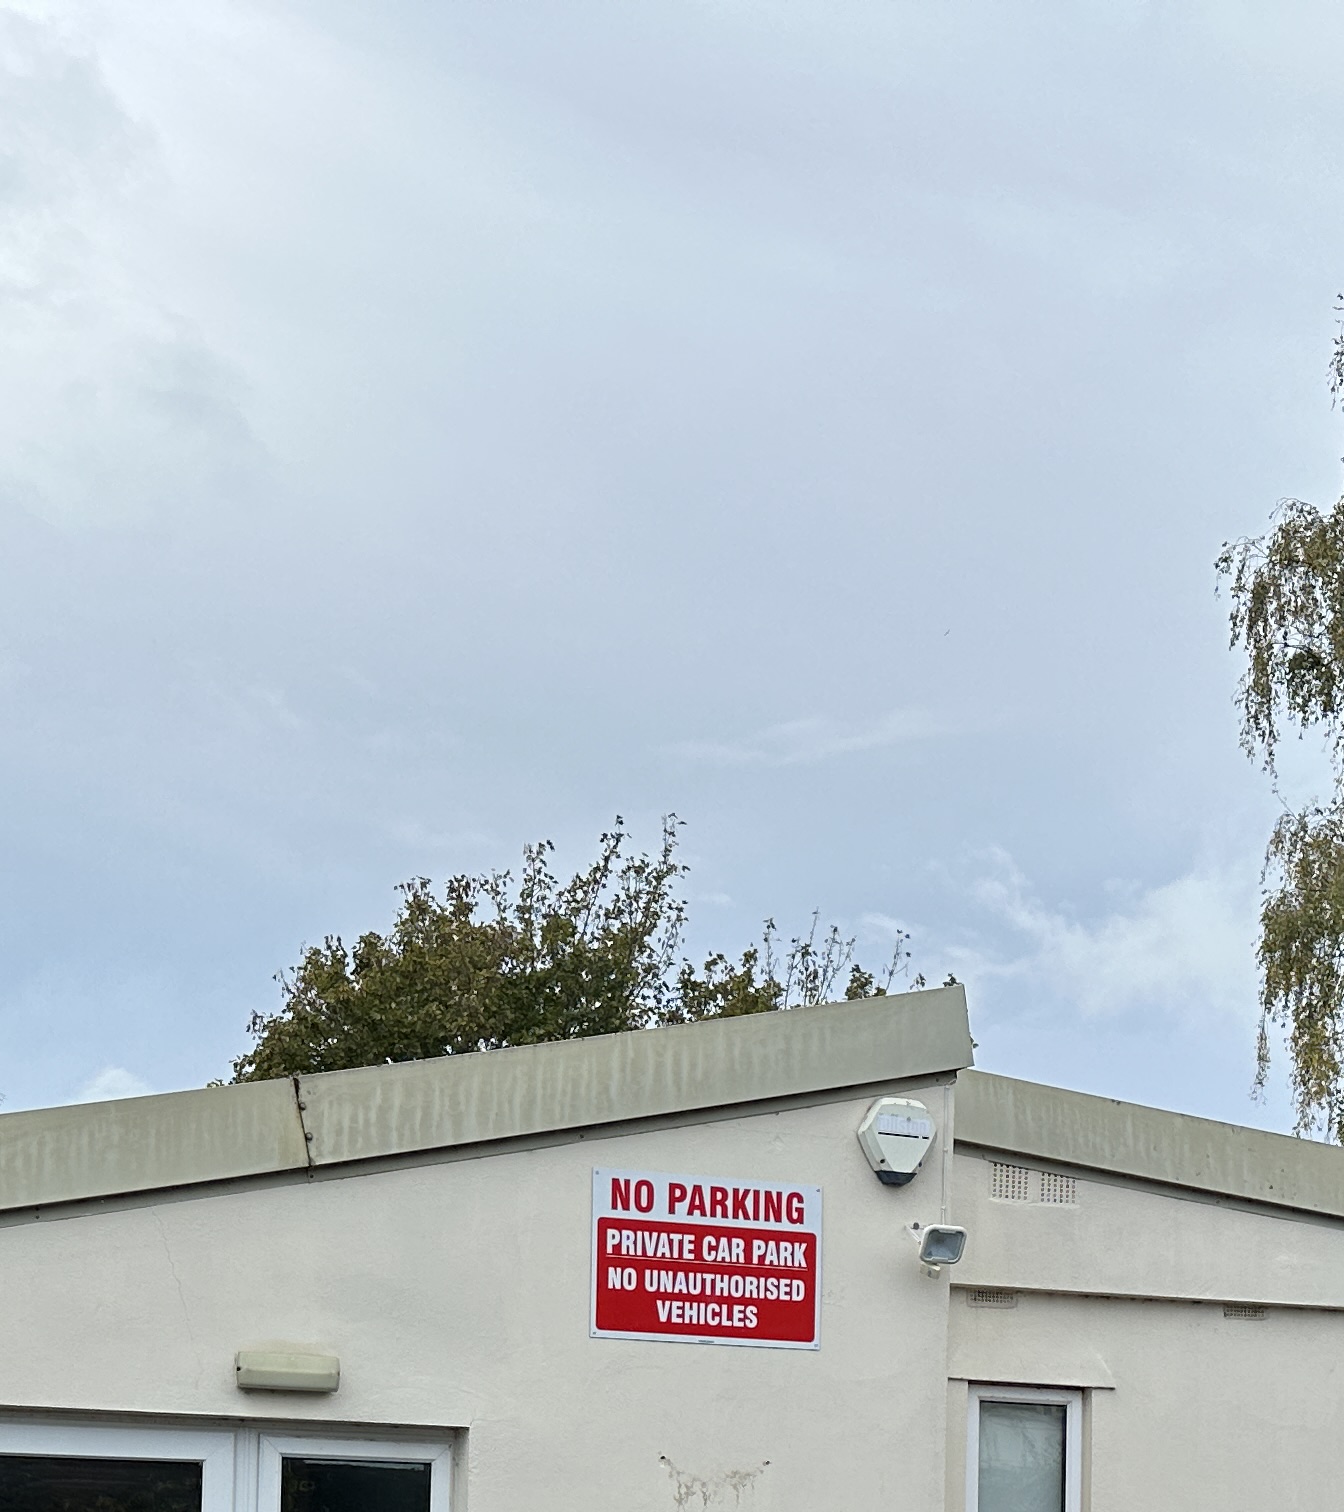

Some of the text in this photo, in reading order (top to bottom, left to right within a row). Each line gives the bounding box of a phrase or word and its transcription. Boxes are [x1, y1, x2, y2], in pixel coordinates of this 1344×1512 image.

[611, 1178, 805, 1225] NO PARKING
[606, 1228, 807, 1268] PRIVATE CAR PARK
[607, 1267, 805, 1301] NO UNAUTHORISED
[656, 1300, 758, 1328] VEHICLES
